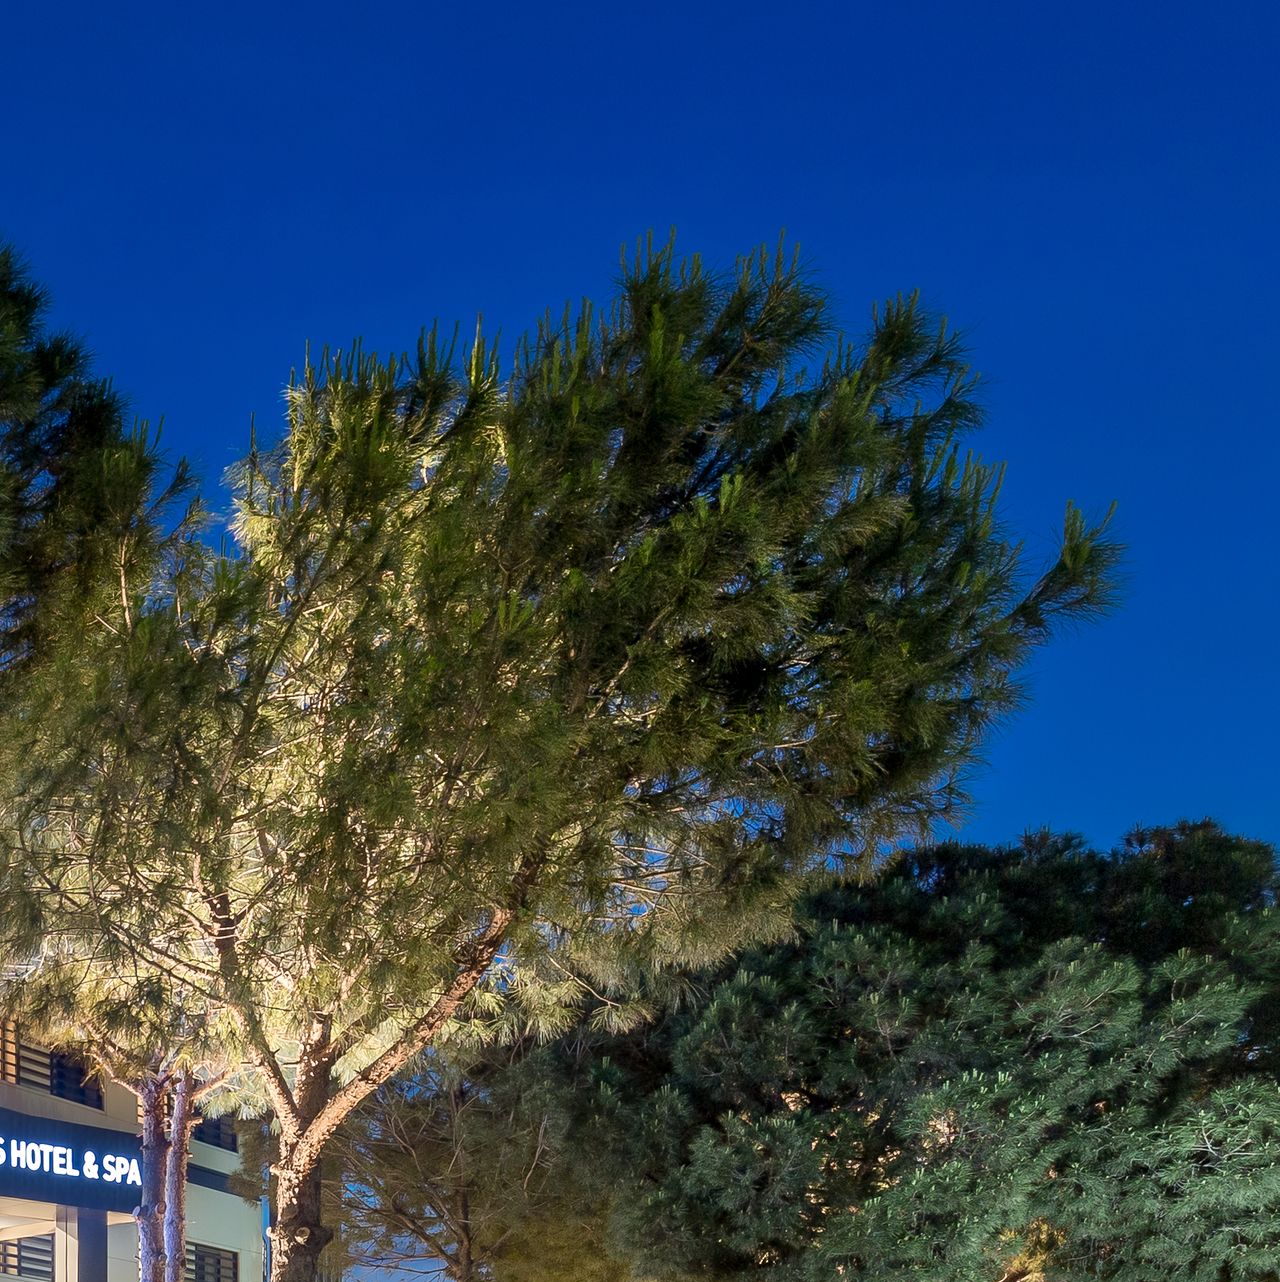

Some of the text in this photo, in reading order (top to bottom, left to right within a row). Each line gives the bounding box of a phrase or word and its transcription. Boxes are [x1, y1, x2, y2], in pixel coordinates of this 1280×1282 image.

[10, 1139, 80, 1177] HOTEL
[83, 1150, 99, 1179] &
[102, 1154, 142, 1185] SPA
